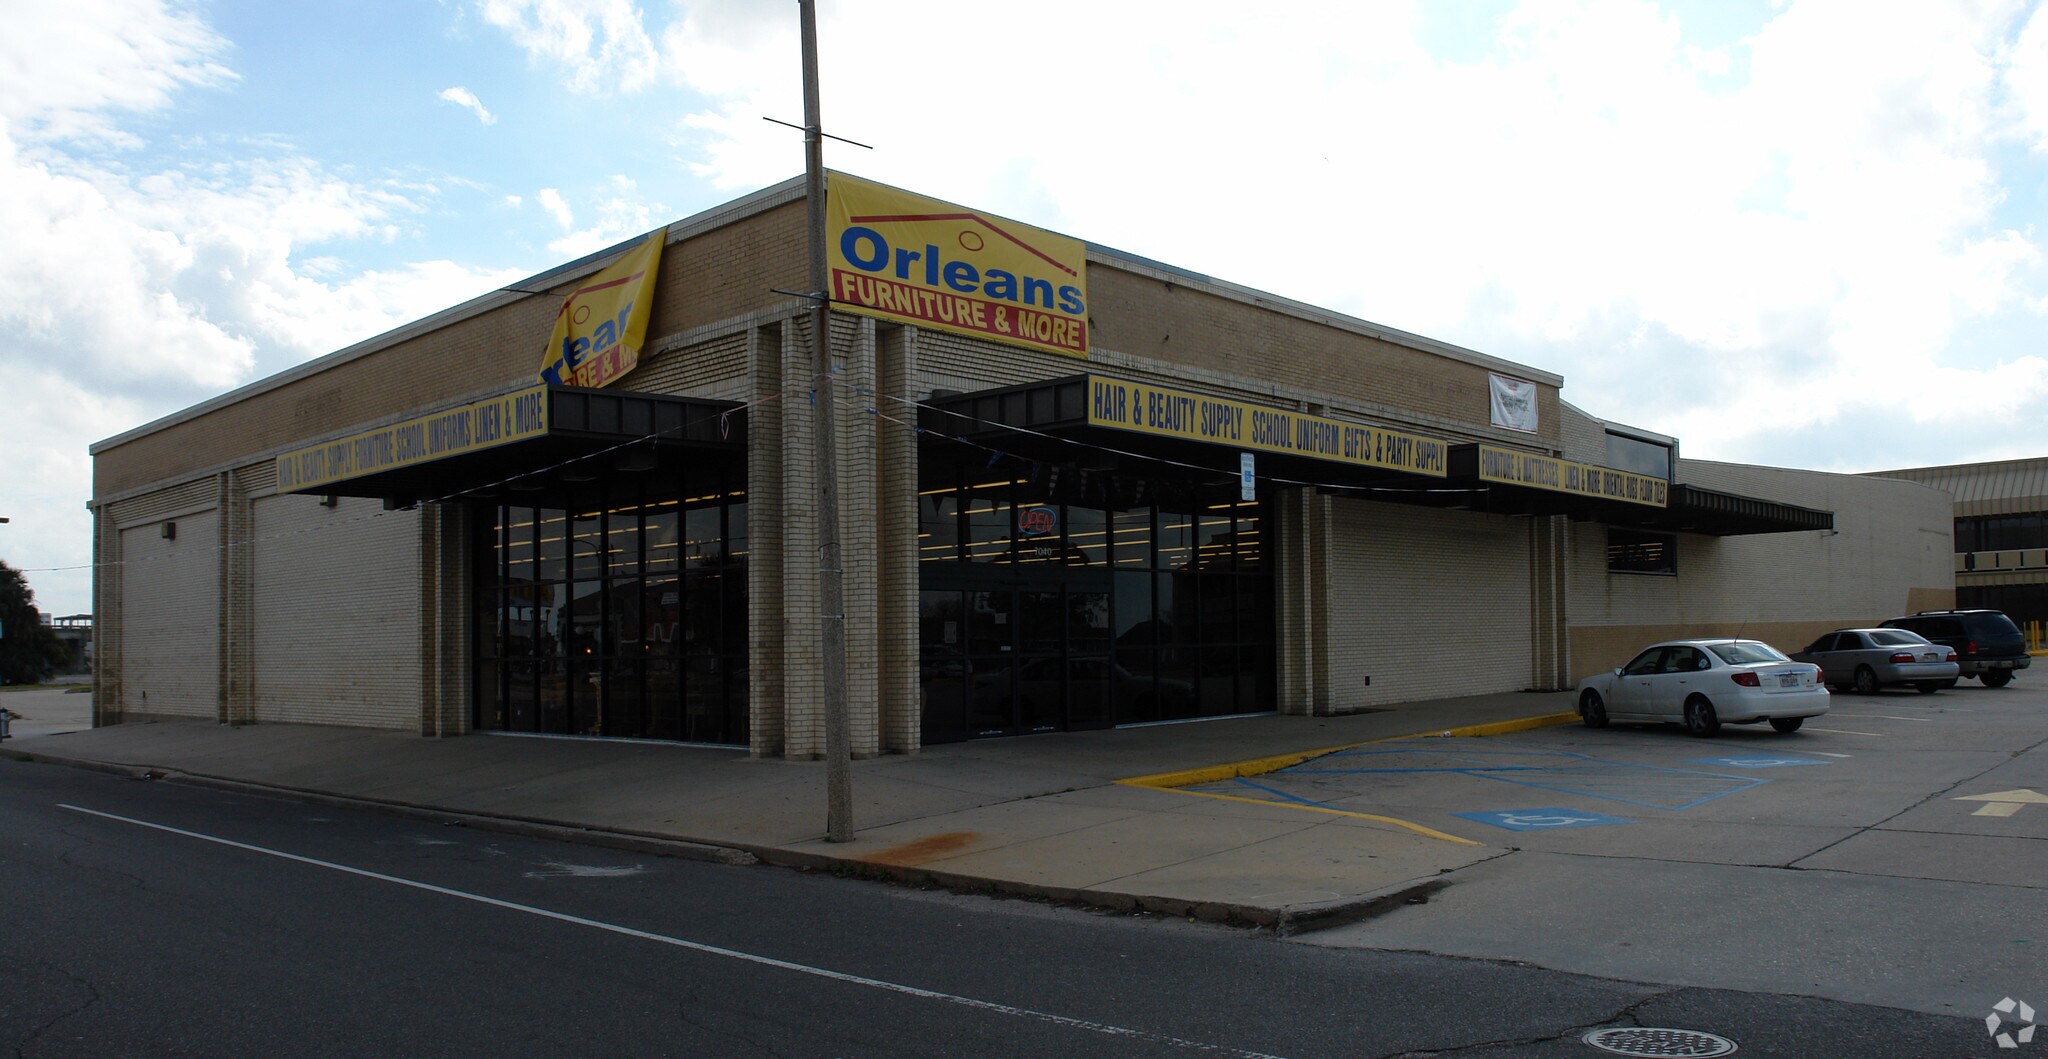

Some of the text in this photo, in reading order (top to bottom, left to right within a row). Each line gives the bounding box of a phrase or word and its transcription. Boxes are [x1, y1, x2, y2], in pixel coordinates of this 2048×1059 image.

[840, 226, 1085, 315] Orleans
[841, 272, 1081, 348] FURNITURE & MORE
[602, 352, 613, 378] &
[302, 447, 325, 483] BEAUTY
[328, 441, 352, 477] SUPPLY
[354, 431, 393, 471] FURNITURE
[396, 422, 426, 462] SCHOOL
[428, 410, 471, 454] UNIFORMS
[474, 402, 501, 444] LINEN
[504, 400, 512, 437] &
[515, 391, 543, 434] MORE
[1094, 382, 1444, 472] HAIR & BEAUTY SUPPLY SCHOOL UNIFORM GIFTS & PARTY SUPPLY
[1482, 448, 1515, 480] FURNITURE
[1523, 456, 1559, 487] MATTRESSES
[1565, 464, 1579, 490] LINEN
[1587, 469, 1600, 493] MORE
[1604, 471, 1625, 497] ORIENTAL
[1654, 481, 1665, 504] TILES
[1019, 511, 1054, 532] OPEN
[1034, 547, 1052, 556] 7040
